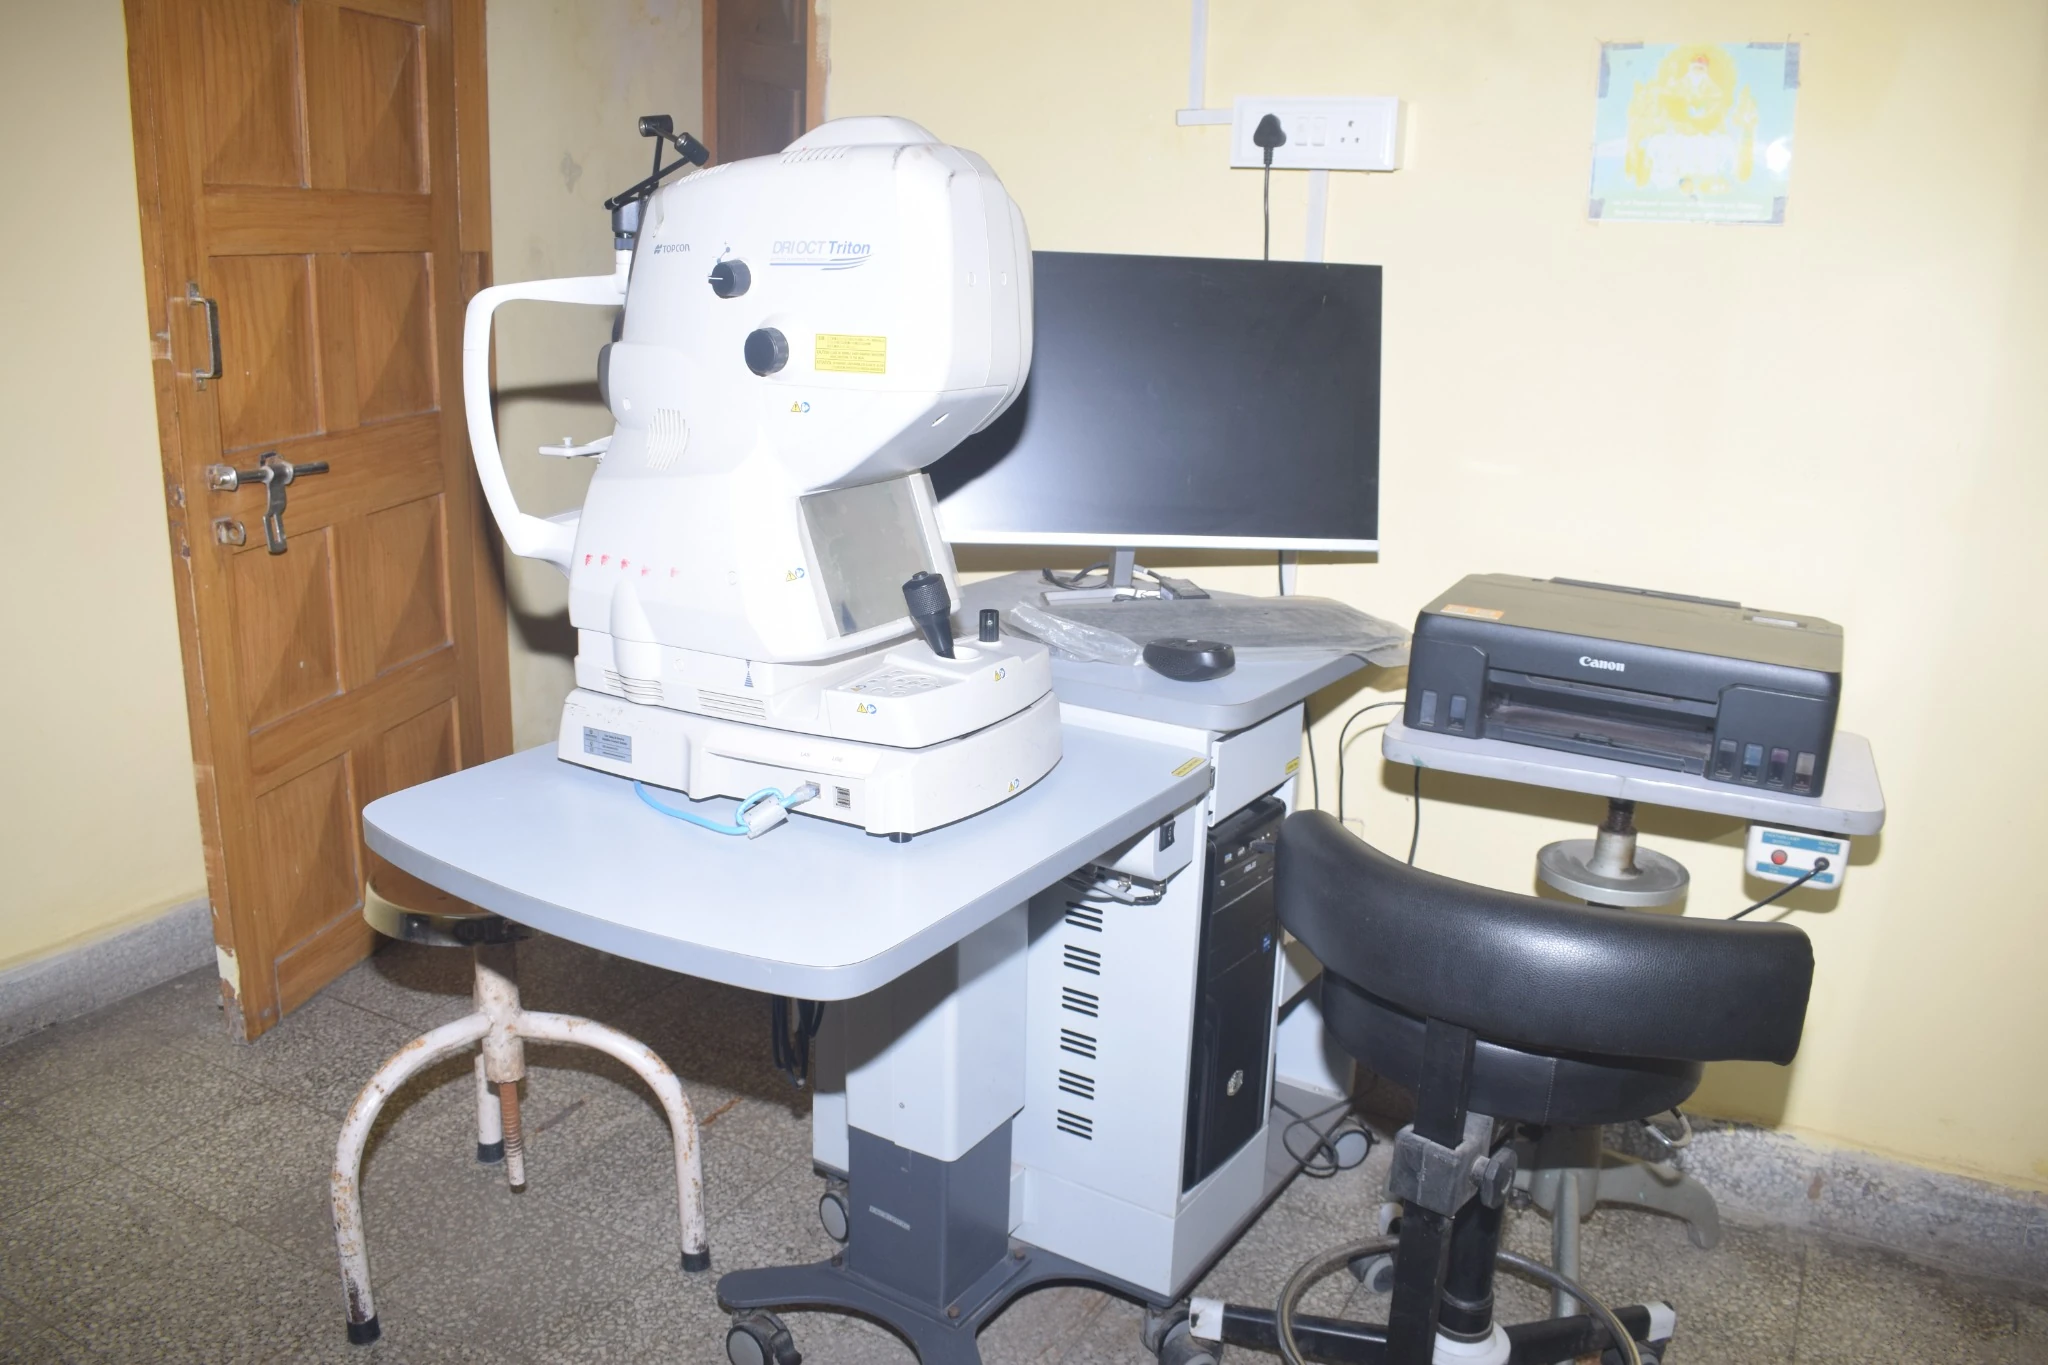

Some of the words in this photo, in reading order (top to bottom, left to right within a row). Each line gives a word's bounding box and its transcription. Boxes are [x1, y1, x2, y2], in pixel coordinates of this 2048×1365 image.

[662, 243, 690, 254] TOPCON
[772, 240, 796, 254] DRI
[795, 240, 827, 254] OCT
[829, 240, 871, 254] Triton
[1578, 655, 1626, 672] Canon
